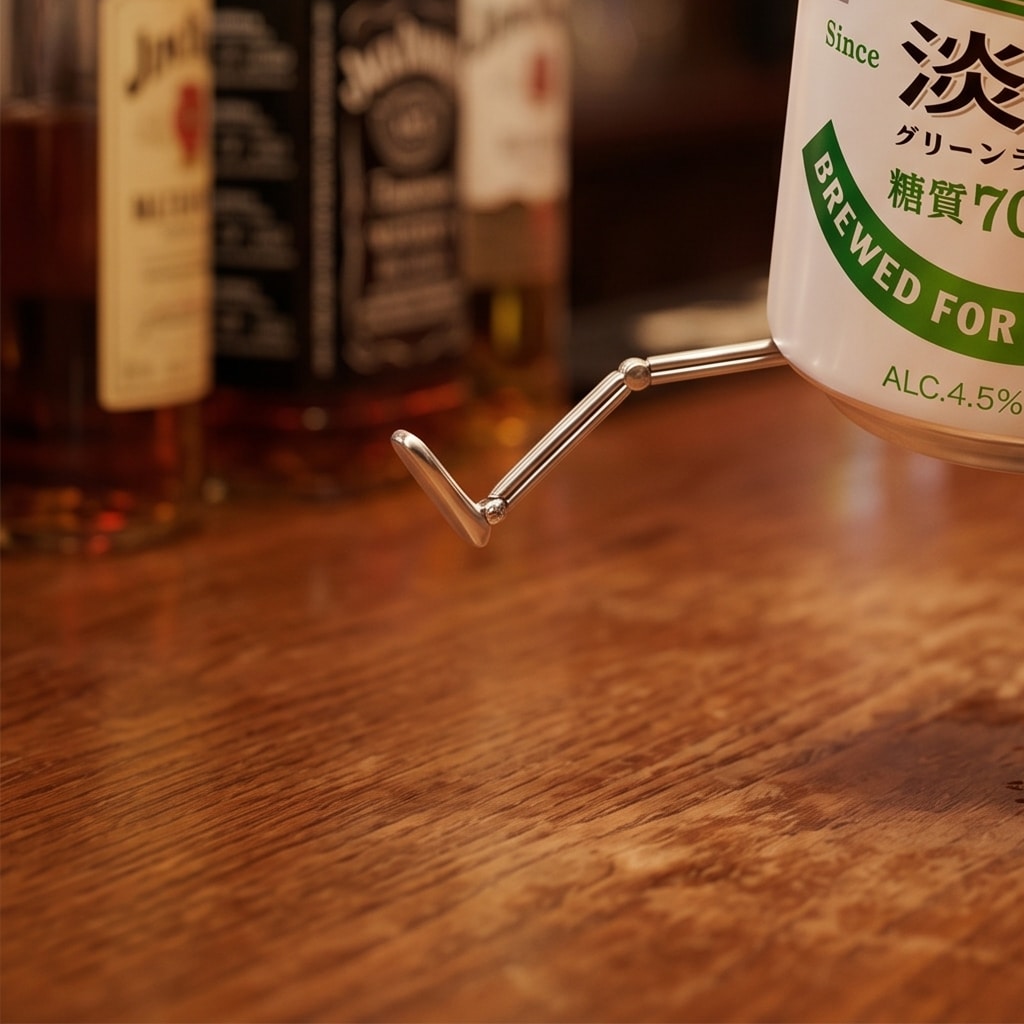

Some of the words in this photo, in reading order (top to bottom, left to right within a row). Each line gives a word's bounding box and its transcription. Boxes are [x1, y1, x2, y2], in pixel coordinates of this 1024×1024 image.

[825, 19, 880, 68] Since
[813, 151, 922, 306] BREWED
[930, 289, 1016, 344] FOR
